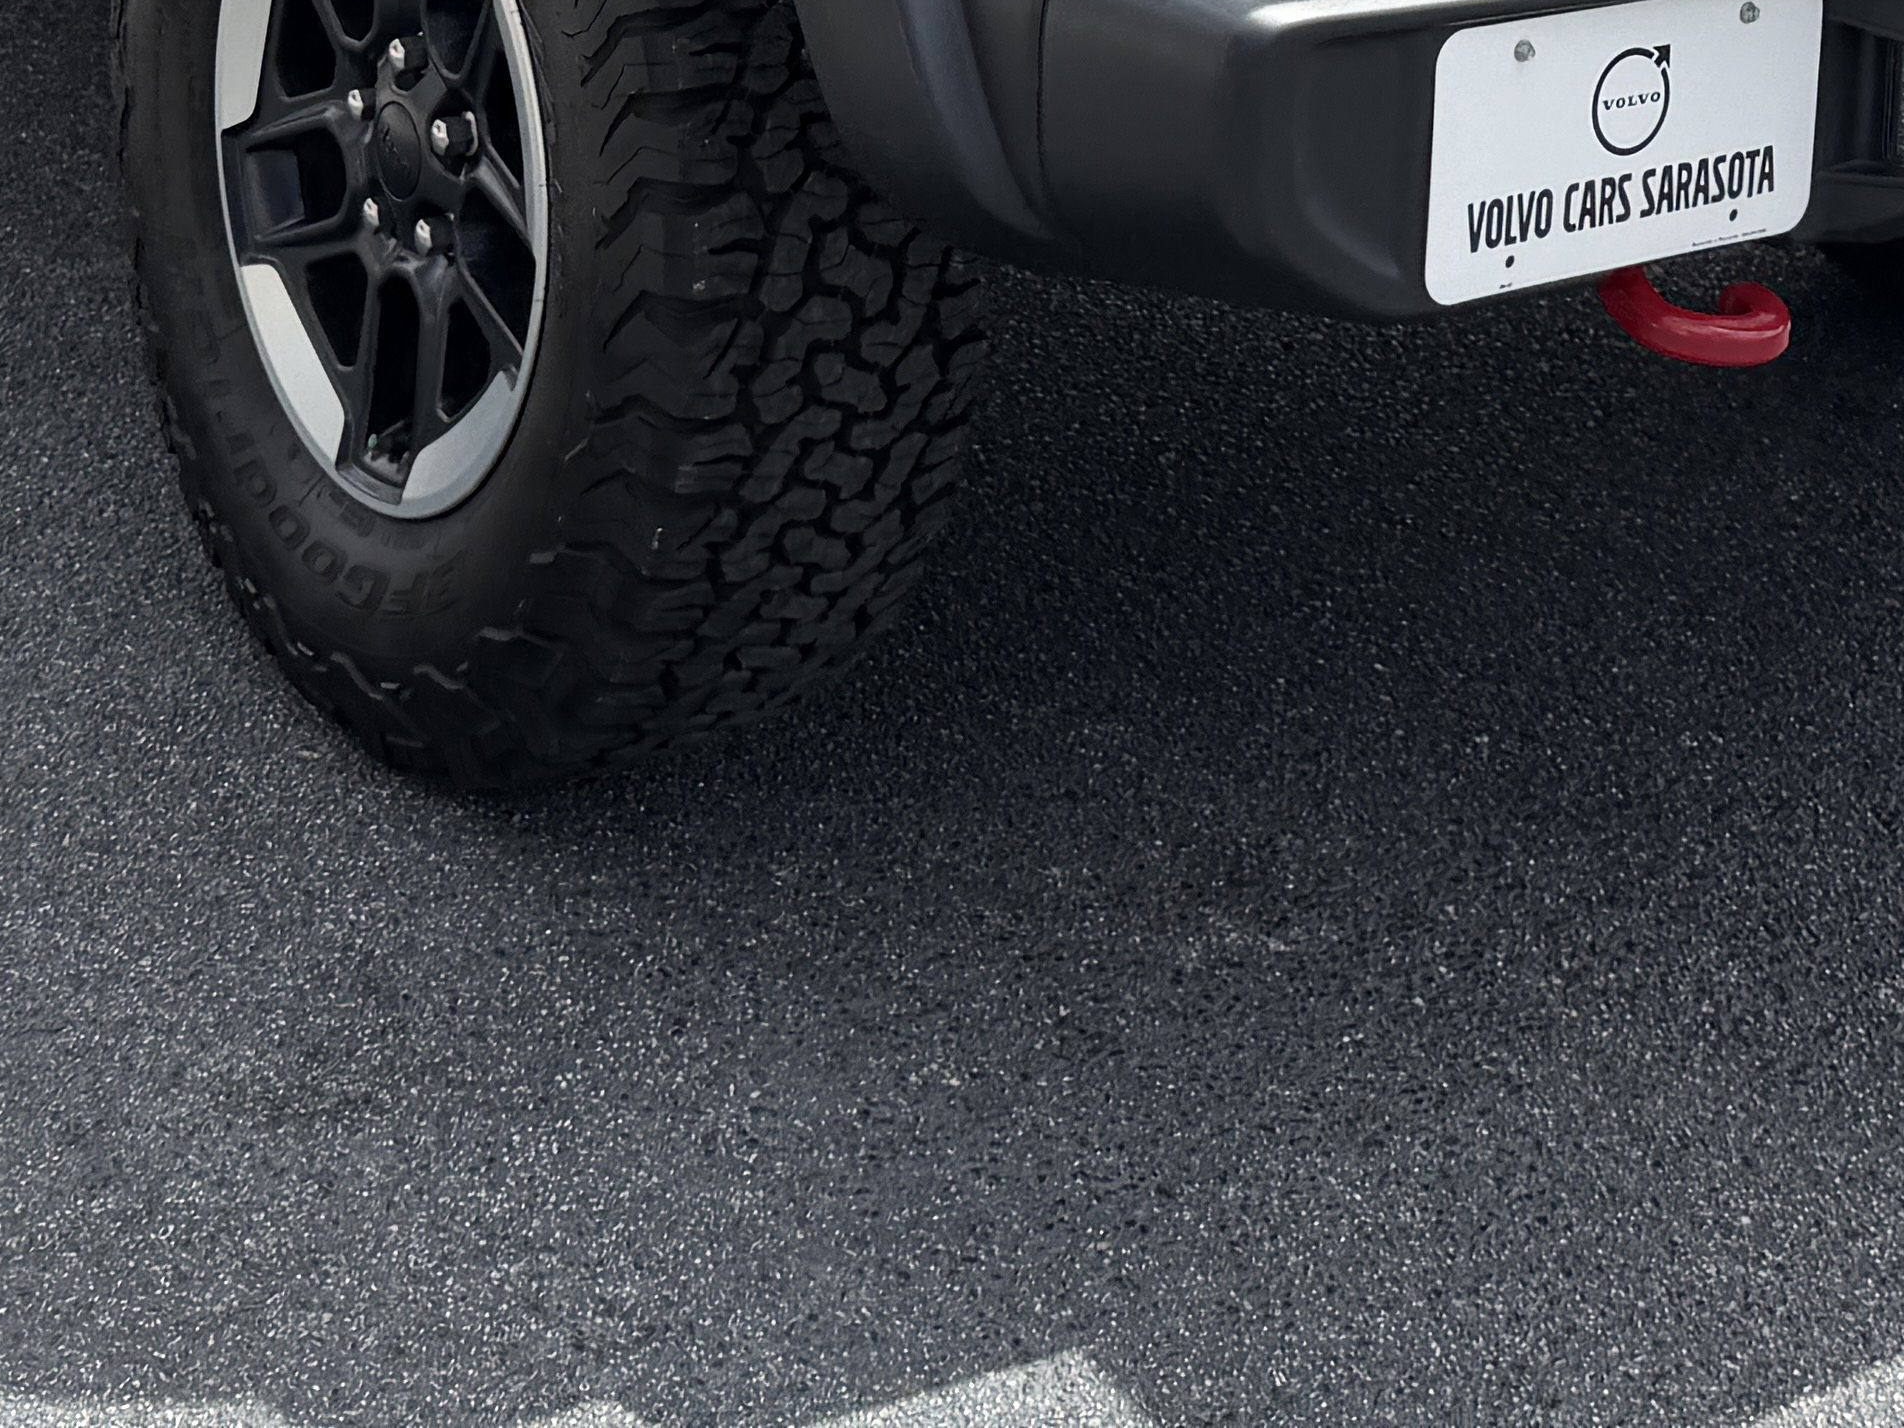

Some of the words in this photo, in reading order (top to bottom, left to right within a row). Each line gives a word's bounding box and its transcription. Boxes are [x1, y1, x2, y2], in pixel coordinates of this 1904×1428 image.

[1602, 91, 1661, 111] VOLVO
[1467, 188, 1554, 254] VOLVO
[1562, 173, 1632, 232] CARS
[1639, 145, 1776, 219] SARASOTA
